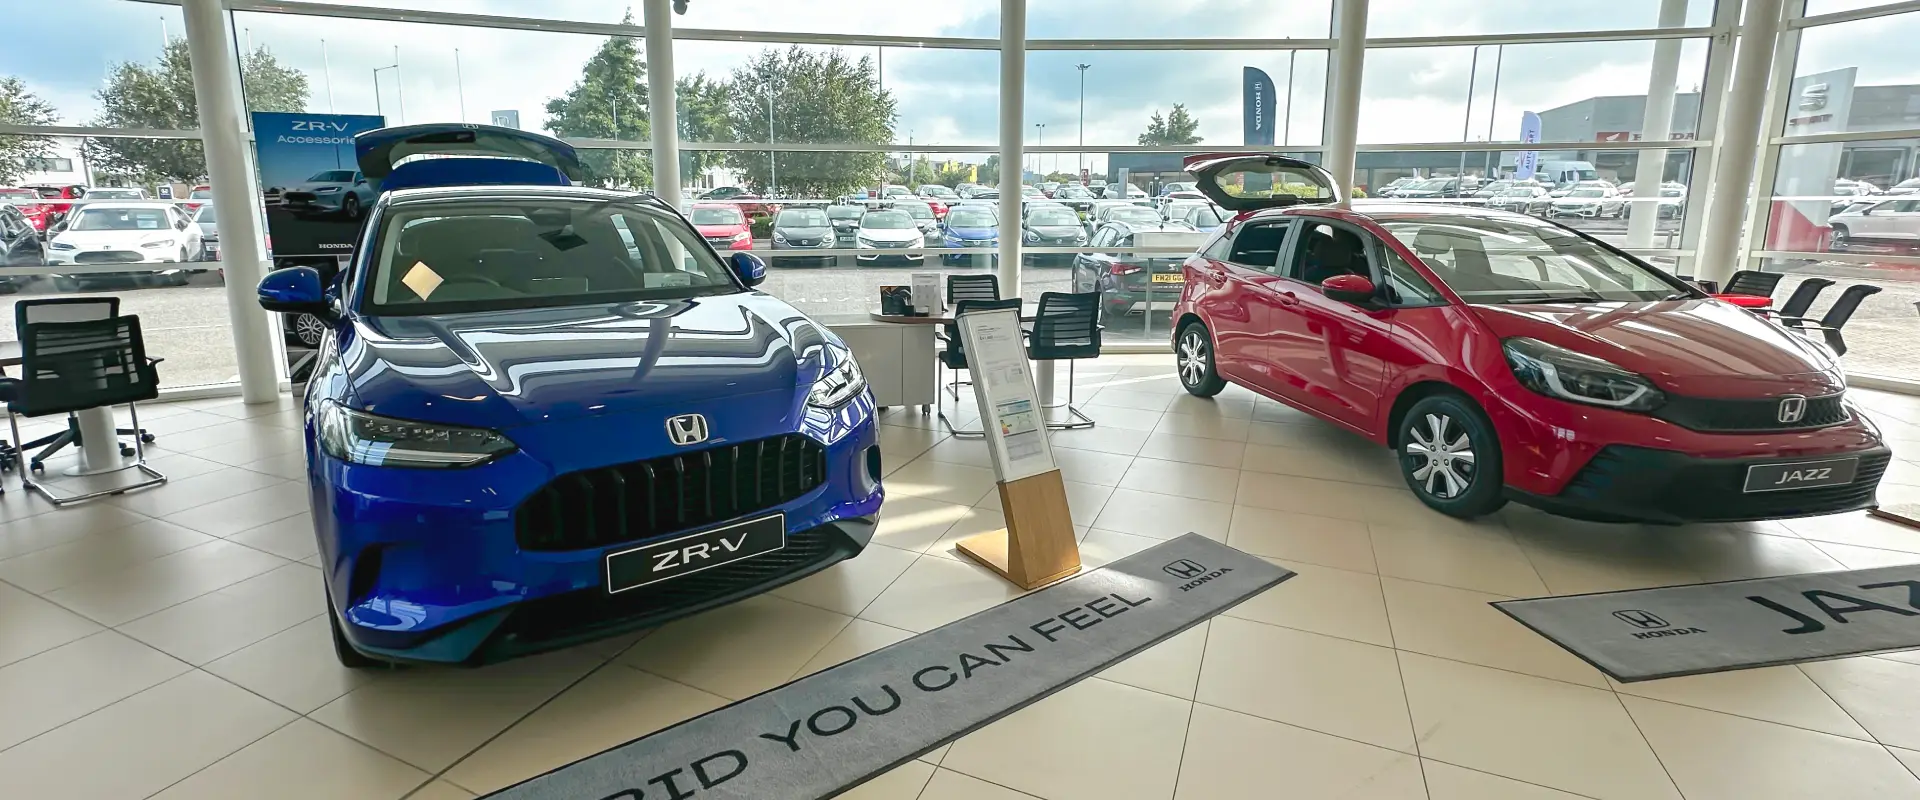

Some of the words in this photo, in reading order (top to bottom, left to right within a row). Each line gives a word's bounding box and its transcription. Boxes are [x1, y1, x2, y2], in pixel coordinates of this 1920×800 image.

[291, 120, 349, 132] ZR-V
[277, 134, 355, 145] Accessorie
[1632, 132, 1695, 141] HDA
[1774, 467, 1832, 485] JAZZ
[652, 532, 748, 573] ZR-V
[1178, 567, 1234, 592] HONDA
[1630, 627, 1708, 640] HONDA
[598, 750, 749, 800] ID
[759, 684, 901, 752] YOU
[912, 634, 1036, 692] CAN
[1029, 592, 1152, 643] FEEL
